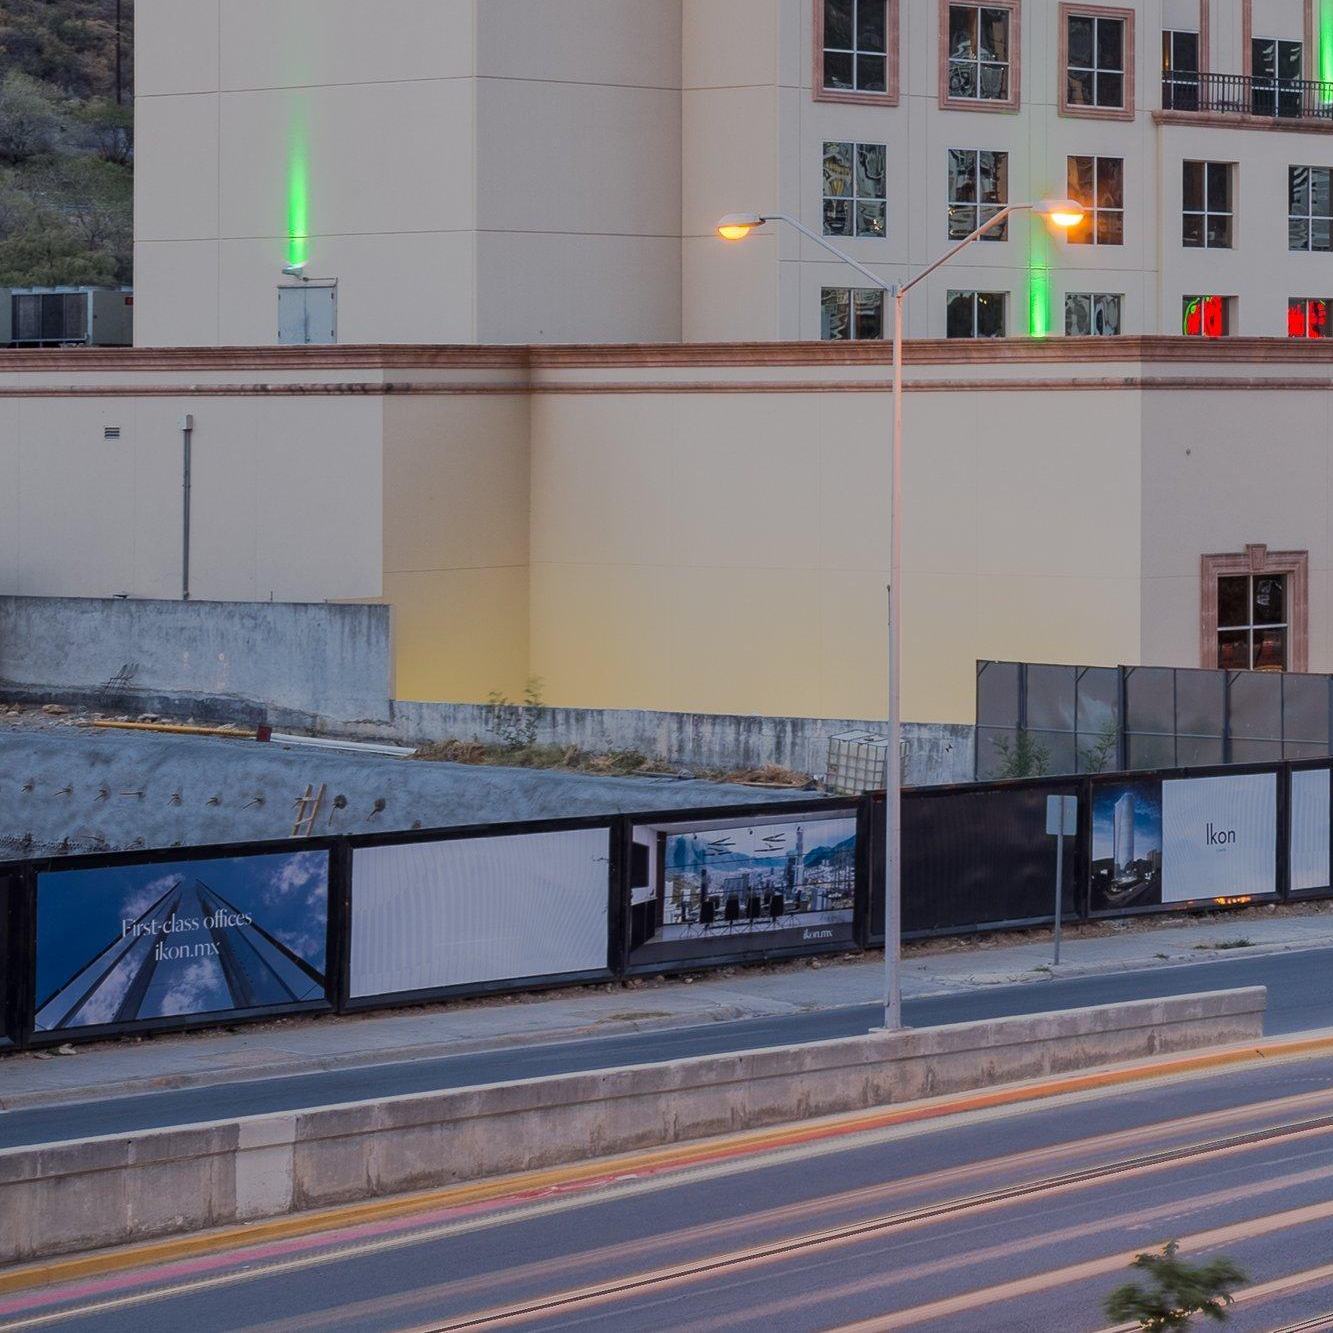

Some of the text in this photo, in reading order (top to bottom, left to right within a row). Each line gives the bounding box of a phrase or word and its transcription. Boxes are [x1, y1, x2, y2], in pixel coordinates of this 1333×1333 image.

[1206, 822, 1236, 845] Ikon
[121, 908, 252, 938] First-class offices
[155, 940, 220, 961] ikon.mx
